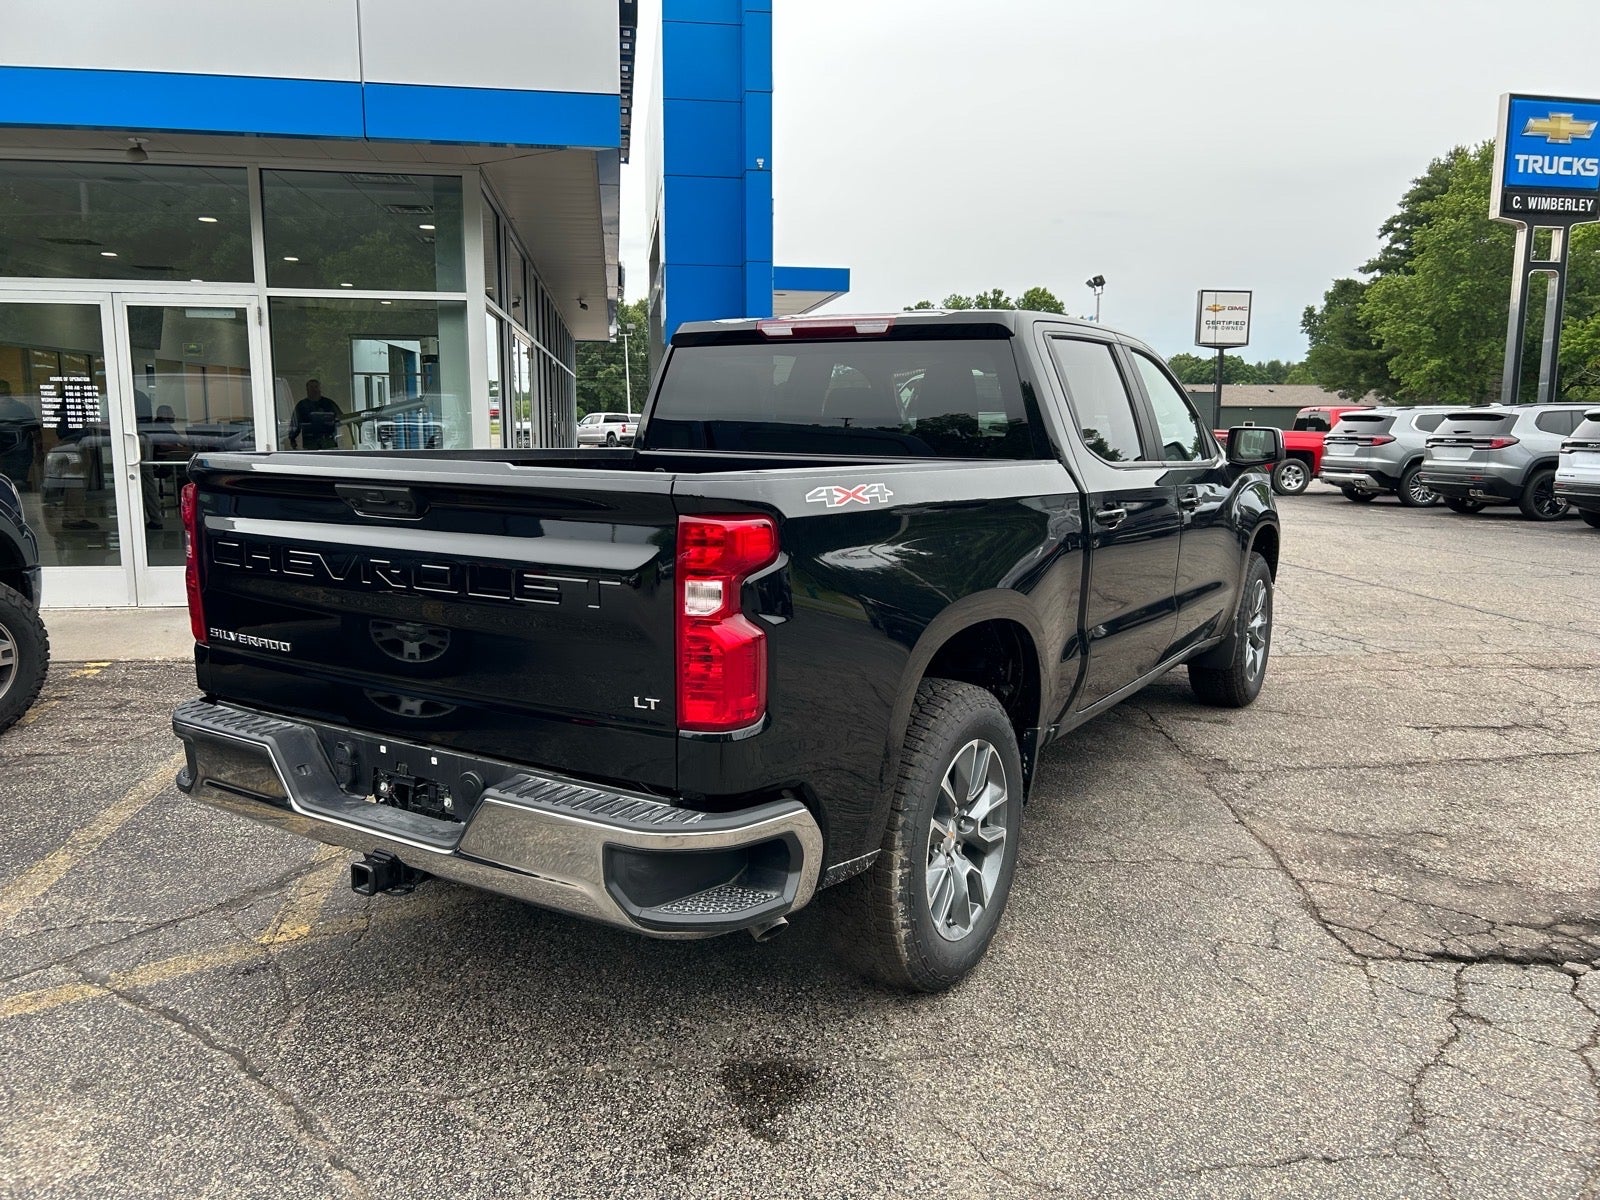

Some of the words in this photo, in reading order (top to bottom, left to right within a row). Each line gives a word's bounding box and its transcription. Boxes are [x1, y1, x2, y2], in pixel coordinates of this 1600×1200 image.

[1515, 154, 1599, 177] TRUCKS
[1512, 195, 1522, 209] C.
[1527, 196, 1594, 212] WIMBERLEY
[212, 539, 622, 609] CHEVROLET
[209, 626, 293, 653] SILVERADO
[633, 695, 661, 711] LT
